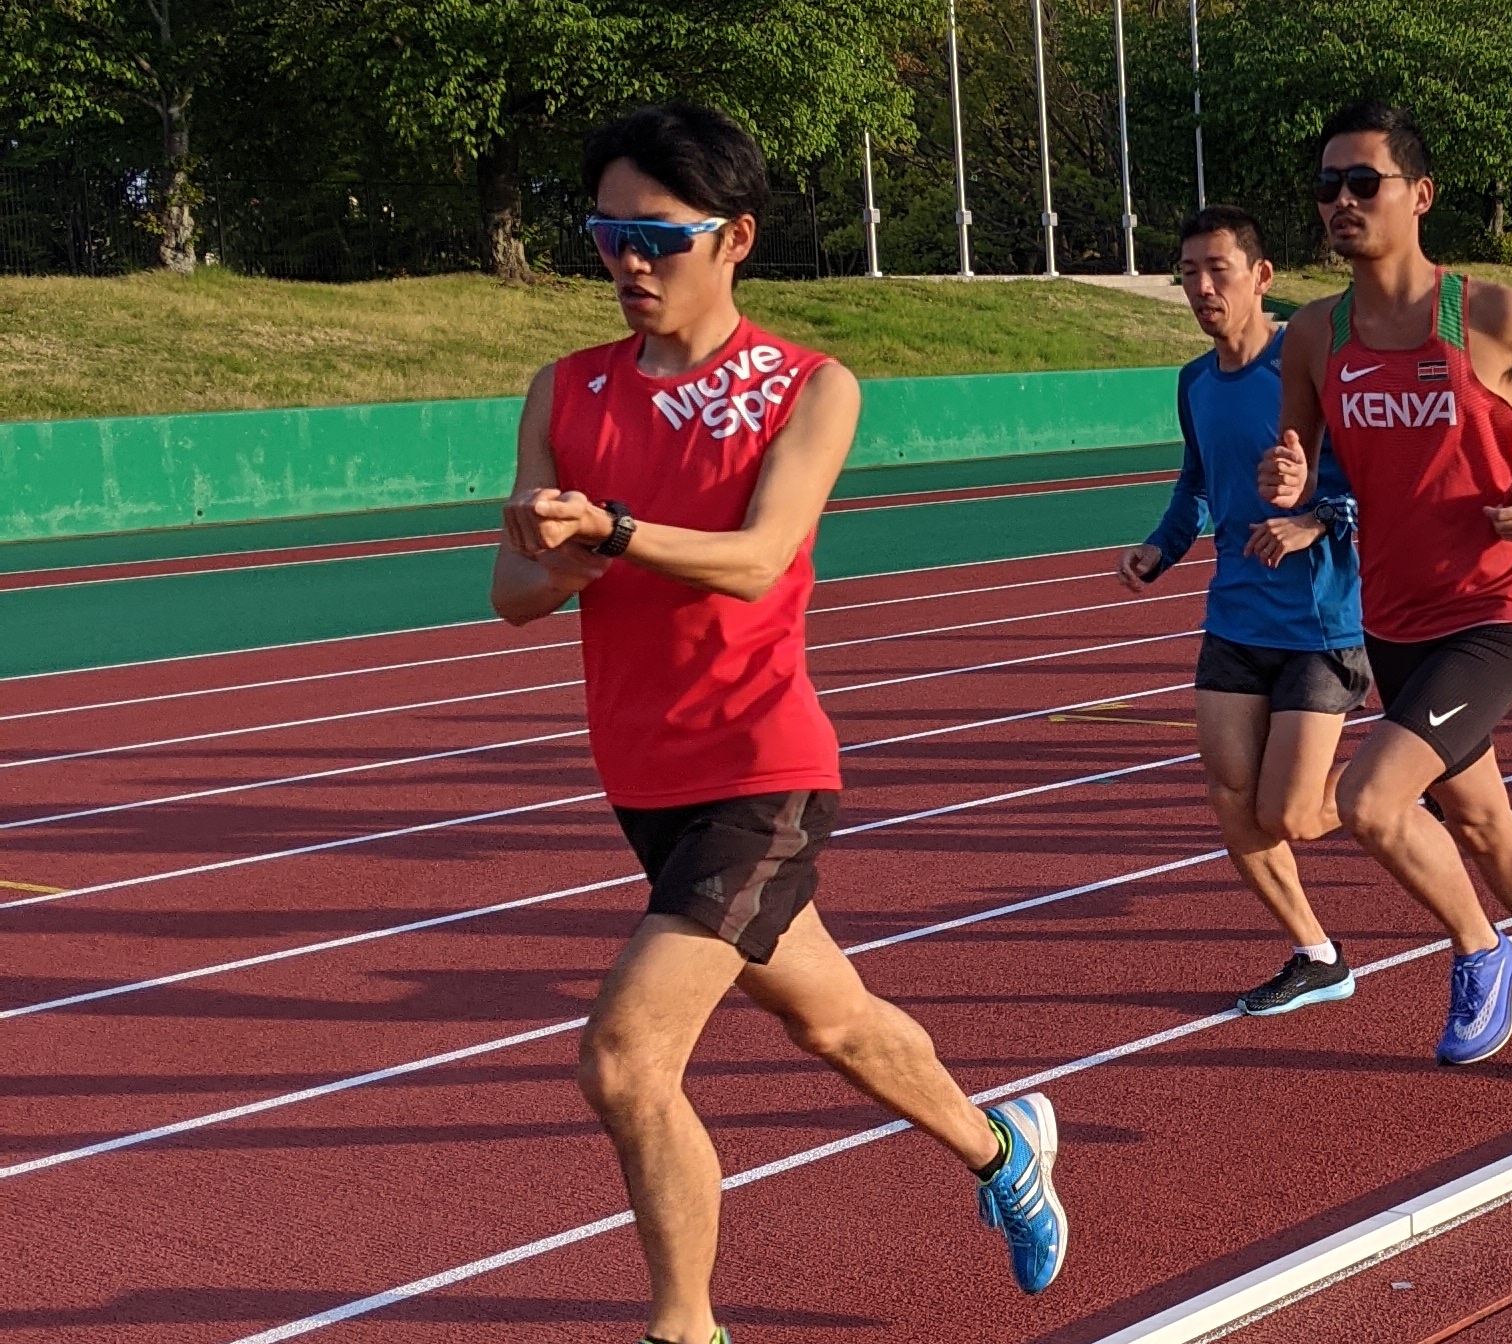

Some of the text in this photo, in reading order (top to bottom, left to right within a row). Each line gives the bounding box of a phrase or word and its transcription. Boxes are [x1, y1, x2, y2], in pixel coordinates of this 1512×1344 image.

[652, 346, 784, 430] Move
[701, 367, 800, 440] Spo
[1341, 391, 1457, 428] KENYA
